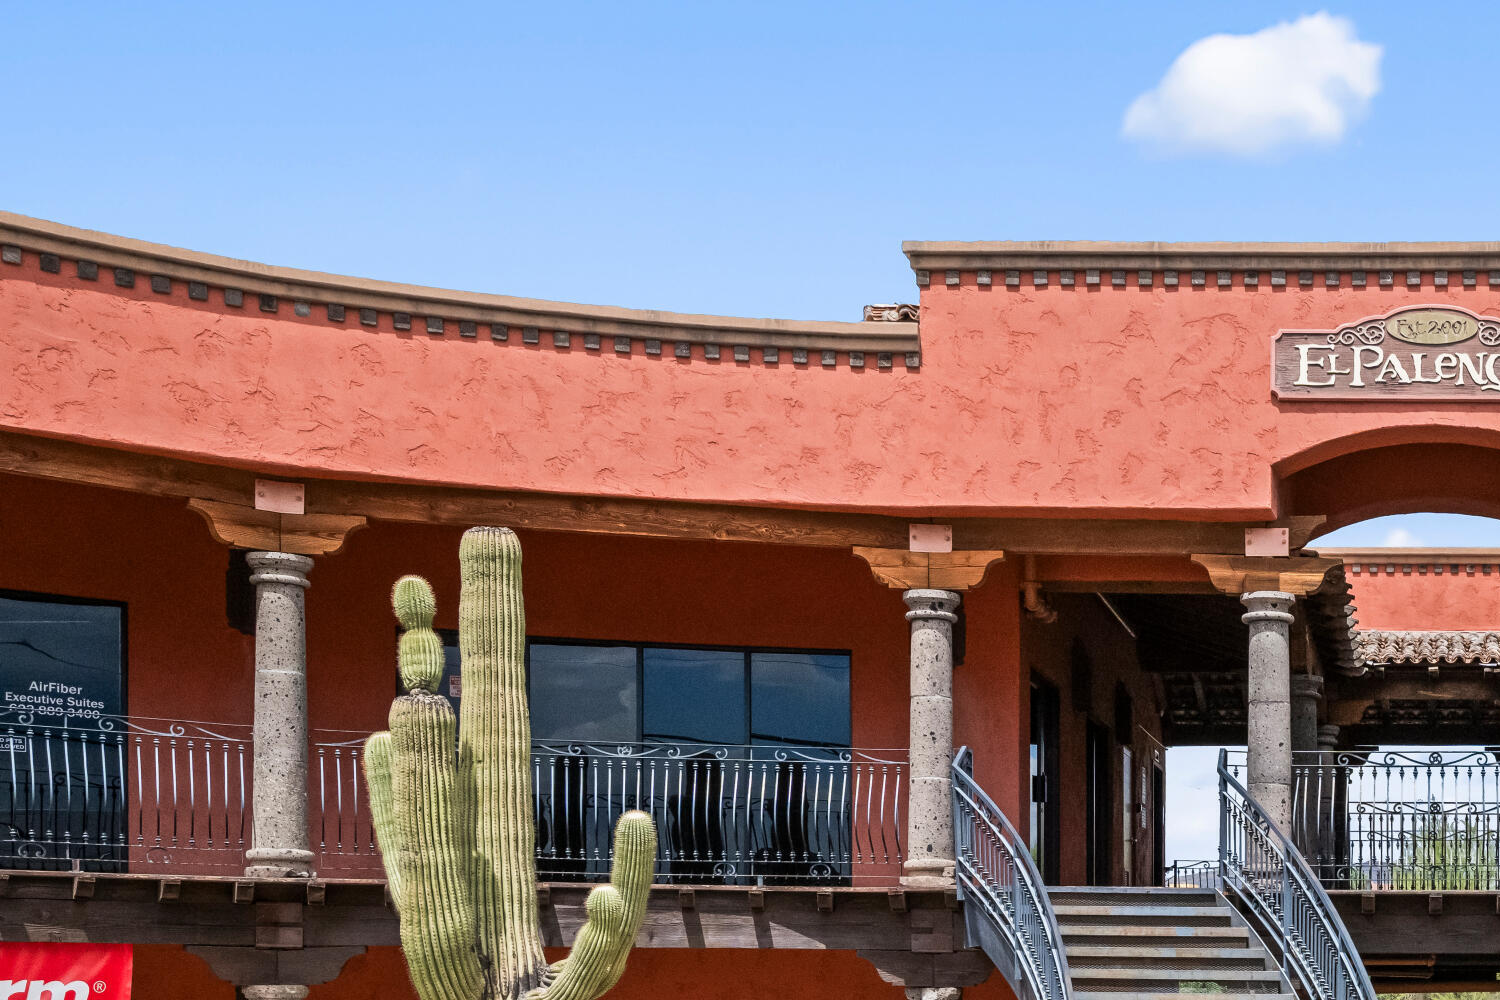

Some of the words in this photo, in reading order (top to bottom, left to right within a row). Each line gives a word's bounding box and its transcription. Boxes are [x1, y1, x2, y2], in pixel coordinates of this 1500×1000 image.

[1428, 320, 1467, 335] 2001
[29, 681, 83, 695] AirFiber
[5, 691, 64, 705] Executive
[66, 696, 105, 709] Suites
